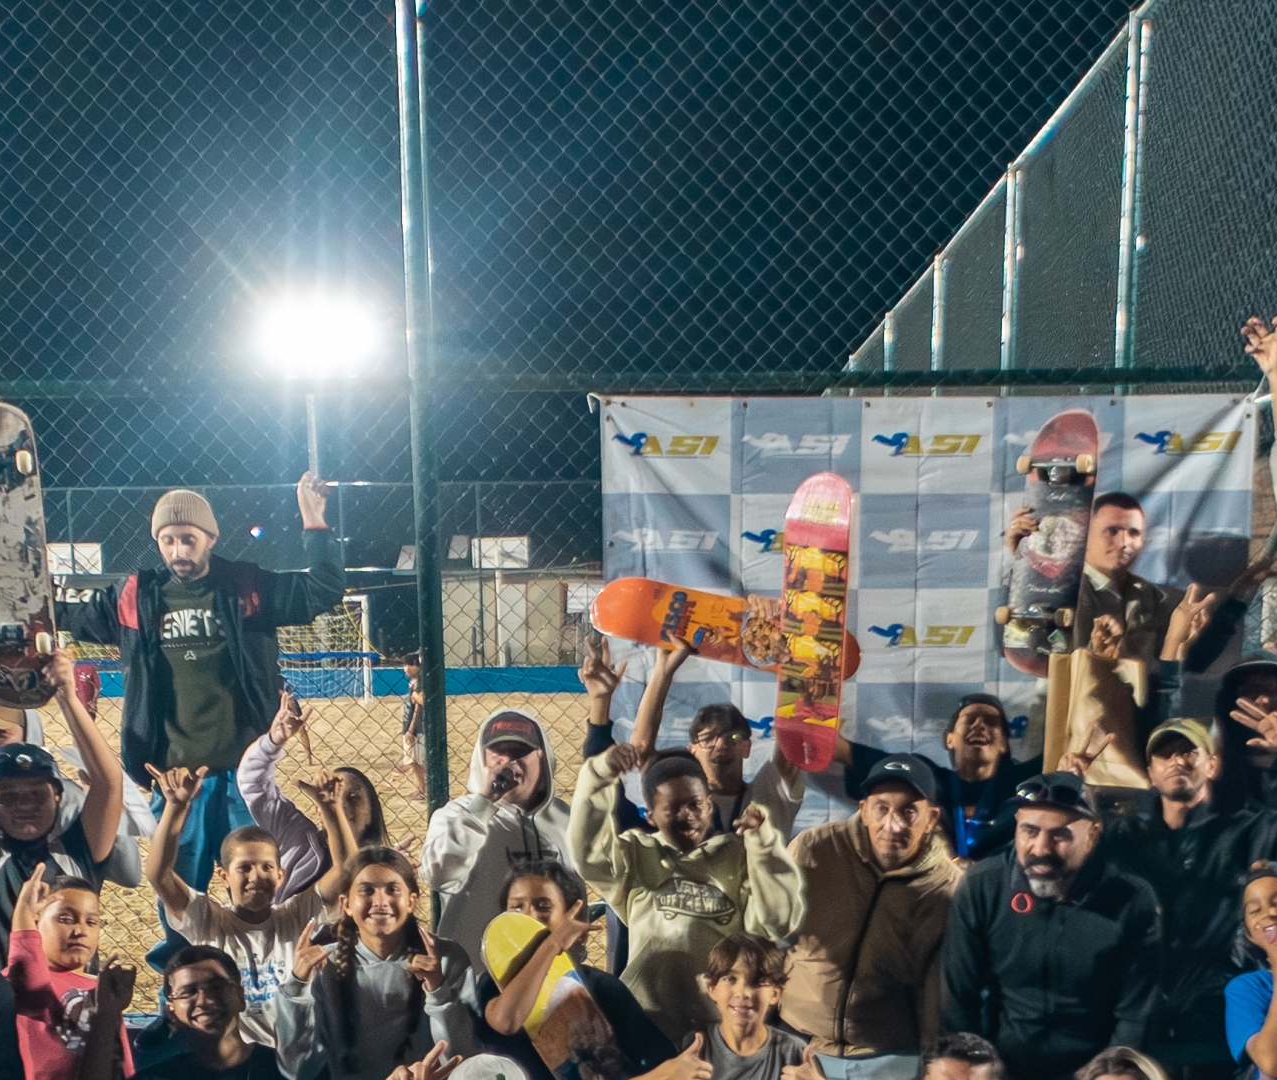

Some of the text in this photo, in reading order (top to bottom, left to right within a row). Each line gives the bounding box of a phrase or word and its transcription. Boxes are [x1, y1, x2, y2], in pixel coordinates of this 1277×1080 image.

[642, 435, 720, 456] ASI
[902, 433, 982, 456] ASI
[898, 625, 976, 645] ASI
